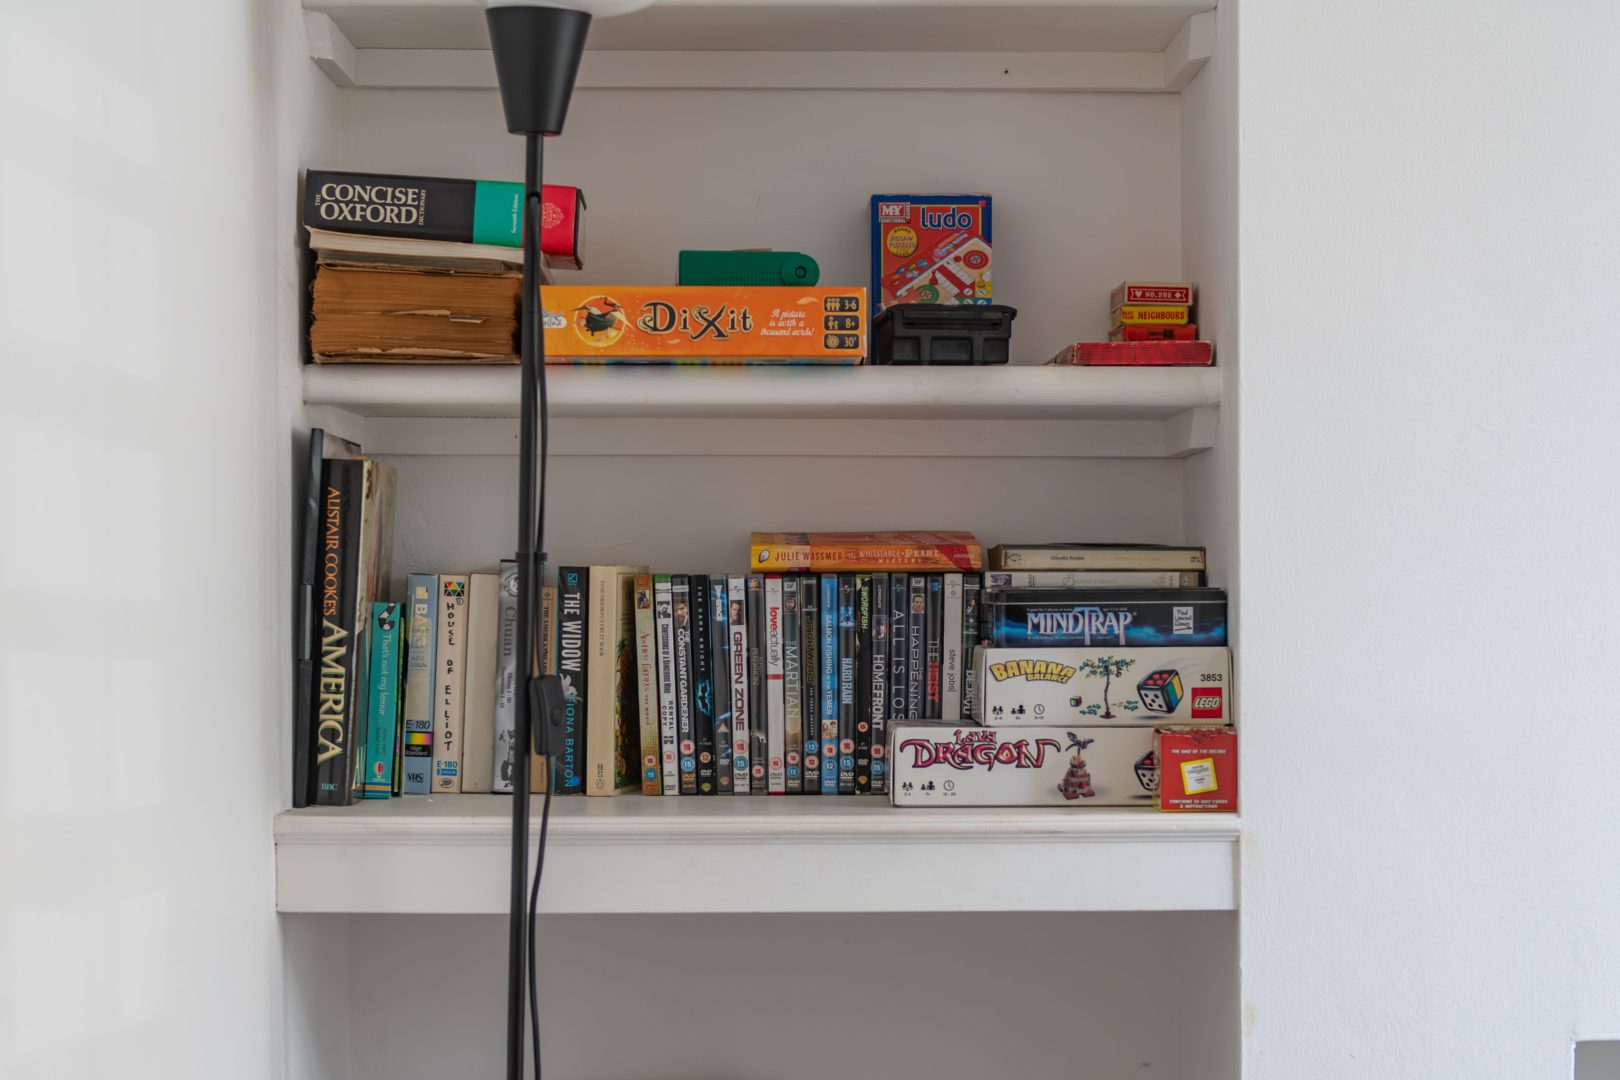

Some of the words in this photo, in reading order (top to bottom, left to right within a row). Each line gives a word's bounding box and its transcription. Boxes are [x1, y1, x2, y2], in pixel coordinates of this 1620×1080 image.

[320, 183, 419, 205] CONCISE
[319, 201, 417, 224] OXFORD
[418, 189, 428, 226] DICTIONARY
[920, 205, 973, 230] ludo
[780, 309, 806, 319] picture
[844, 299, 857, 309] 3-6
[1138, 311, 1185, 321] NEIGHBOURS
[761, 328, 790, 336] thousand
[777, 319, 797, 327] worth
[845, 318, 856, 328] 8+
[327, 487, 342, 552] ALISTAIR
[775, 552, 799, 561] JULIE
[803, 552, 843, 561] WASSMER
[904, 549, 940, 558] PEARL
[323, 553, 339, 616] COOKE'S
[564, 592, 580, 615] THE
[861, 586, 869, 629] SWORDFISH
[447, 603, 455, 646] HOUSE
[504, 607, 519, 656] Chuan
[806, 616, 816, 650] STAR
[892, 609, 905, 646] ALL
[1027, 606, 1133, 646] MINDTRAP
[381, 633, 392, 657] That's
[561, 620, 582, 672] WIDOW
[677, 628, 688, 679] CONSTANT
[380, 660, 390, 676] not
[446, 660, 454, 675] OF
[733, 632, 744, 684] GREEN
[806, 650, 817, 685] WARS
[842, 658, 853, 682] HARD
[892, 657, 905, 674] IS
[948, 649, 957, 671] steve
[785, 646, 799, 718] MARTIAN
[909, 625, 921, 720] HAPPENING
[989, 659, 1077, 682] BANANA
[1026, 673, 1069, 684] BALANCE
[1200, 673, 1223, 682] 3853
[316, 617, 349, 766] AMERICA
[378, 677, 389, 690] my
[842, 682, 853, 704] RAIN
[872, 655, 884, 731] HOMEFRONT
[565, 696, 575, 733] FIONA
[679, 680, 688, 733] GARDENER
[734, 688, 744, 731] ZONE
[892, 685, 905, 720] LOS
[1194, 697, 1220, 709] LEGO
[406, 720, 432, 729] E-180
[563, 738, 575, 787] BARTON
[684, 760, 692, 768] 15
[737, 759, 745, 767] 15
[899, 739, 1062, 772] DRAGON
[407, 773, 424, 782] VHS
